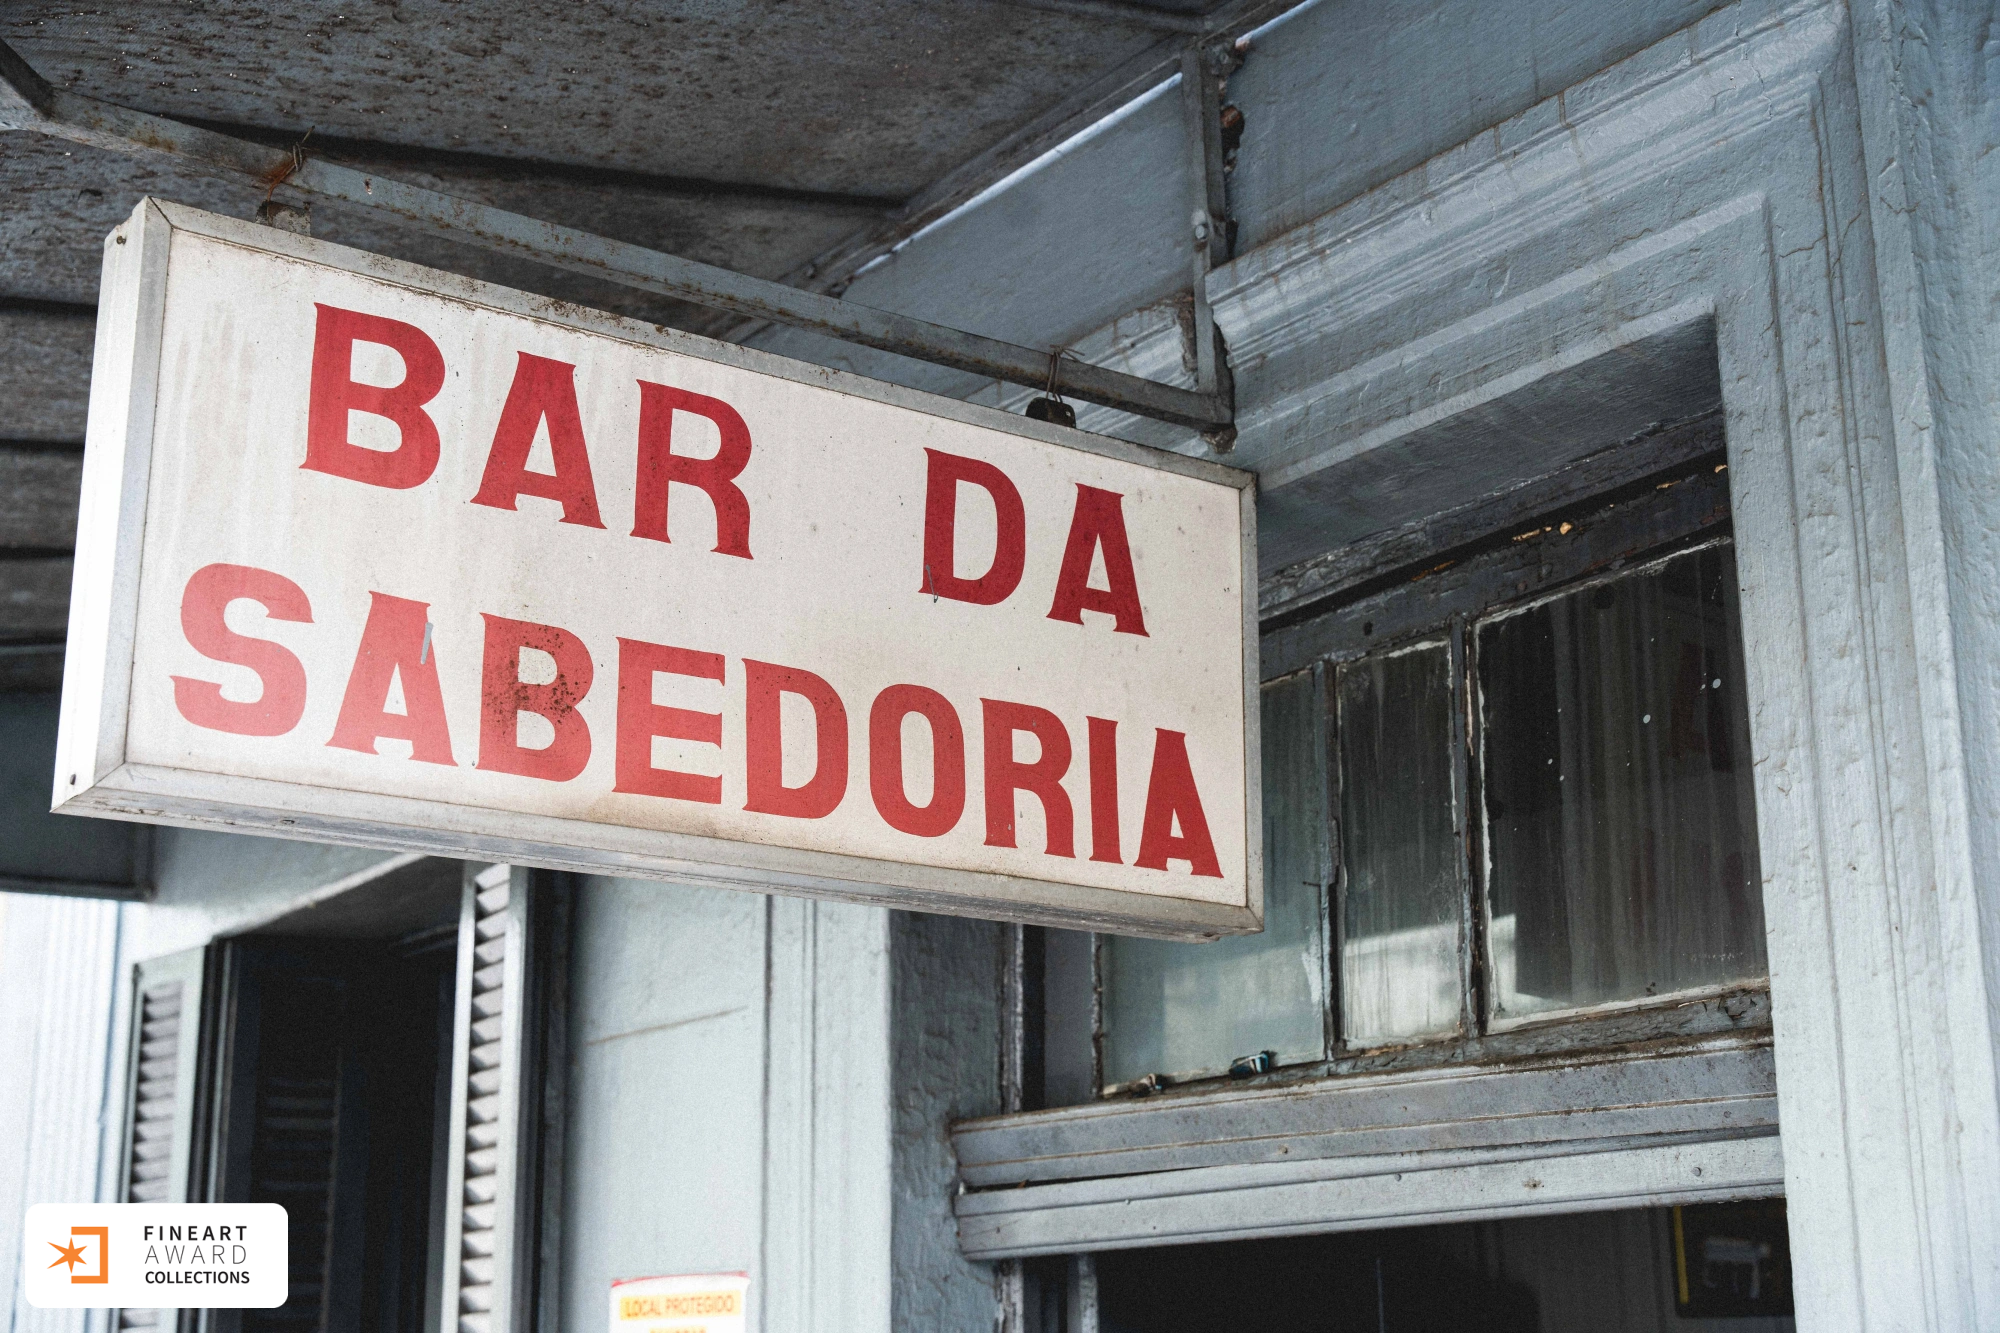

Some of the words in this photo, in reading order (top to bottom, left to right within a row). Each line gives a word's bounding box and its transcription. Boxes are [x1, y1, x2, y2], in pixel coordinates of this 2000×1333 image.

[299, 302, 753, 560] BAR
[918, 447, 1149, 637] DA
[171, 563, 1224, 879] SABEDORIA
[625, 1299, 661, 1318] LOCAL
[665, 1294, 735, 1315] PROTEGIDO
